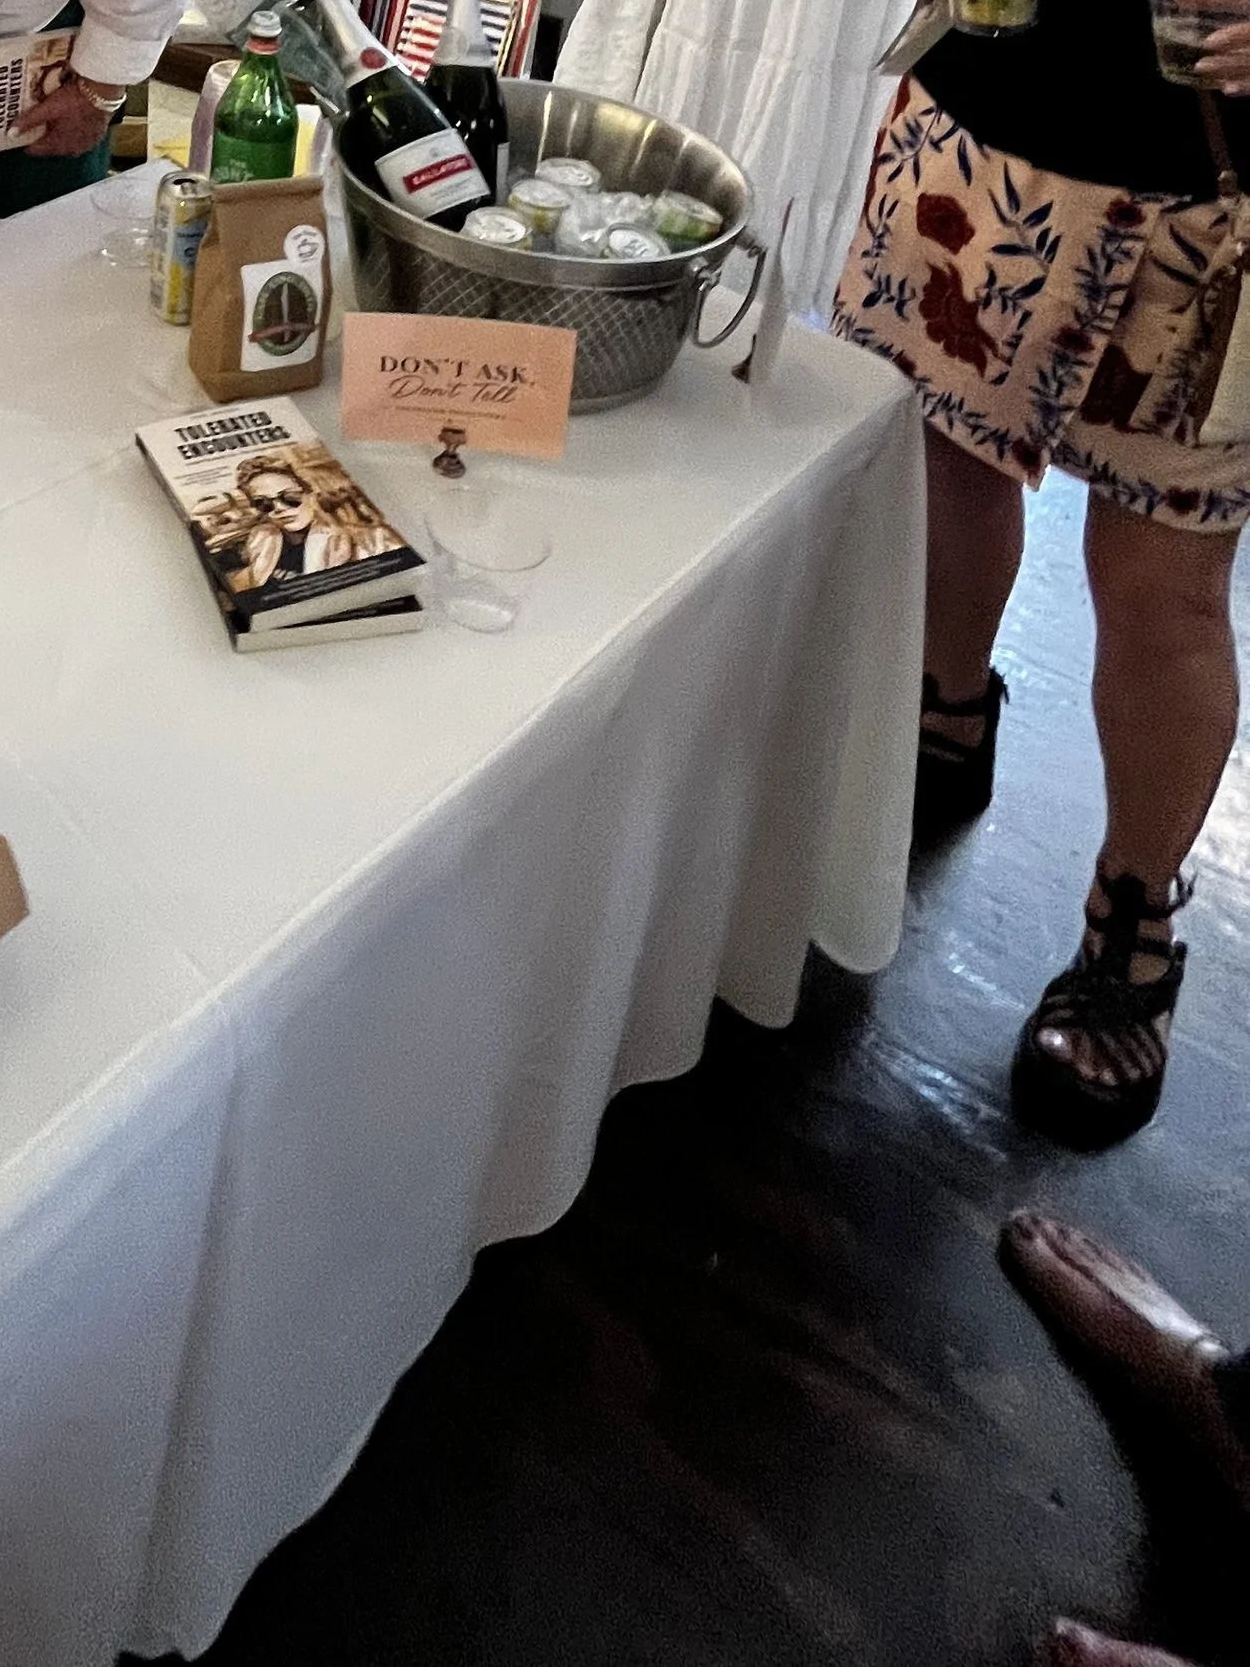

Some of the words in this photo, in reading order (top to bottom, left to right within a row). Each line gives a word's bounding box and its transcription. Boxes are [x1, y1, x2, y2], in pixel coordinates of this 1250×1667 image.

[380, 355, 470, 378] DON'T
[387, 374, 464, 399] Don't
[469, 383, 519, 404] Tell
[174, 411, 272, 442] TOLERATED
[177, 425, 291, 460] ENCOUNTERS
